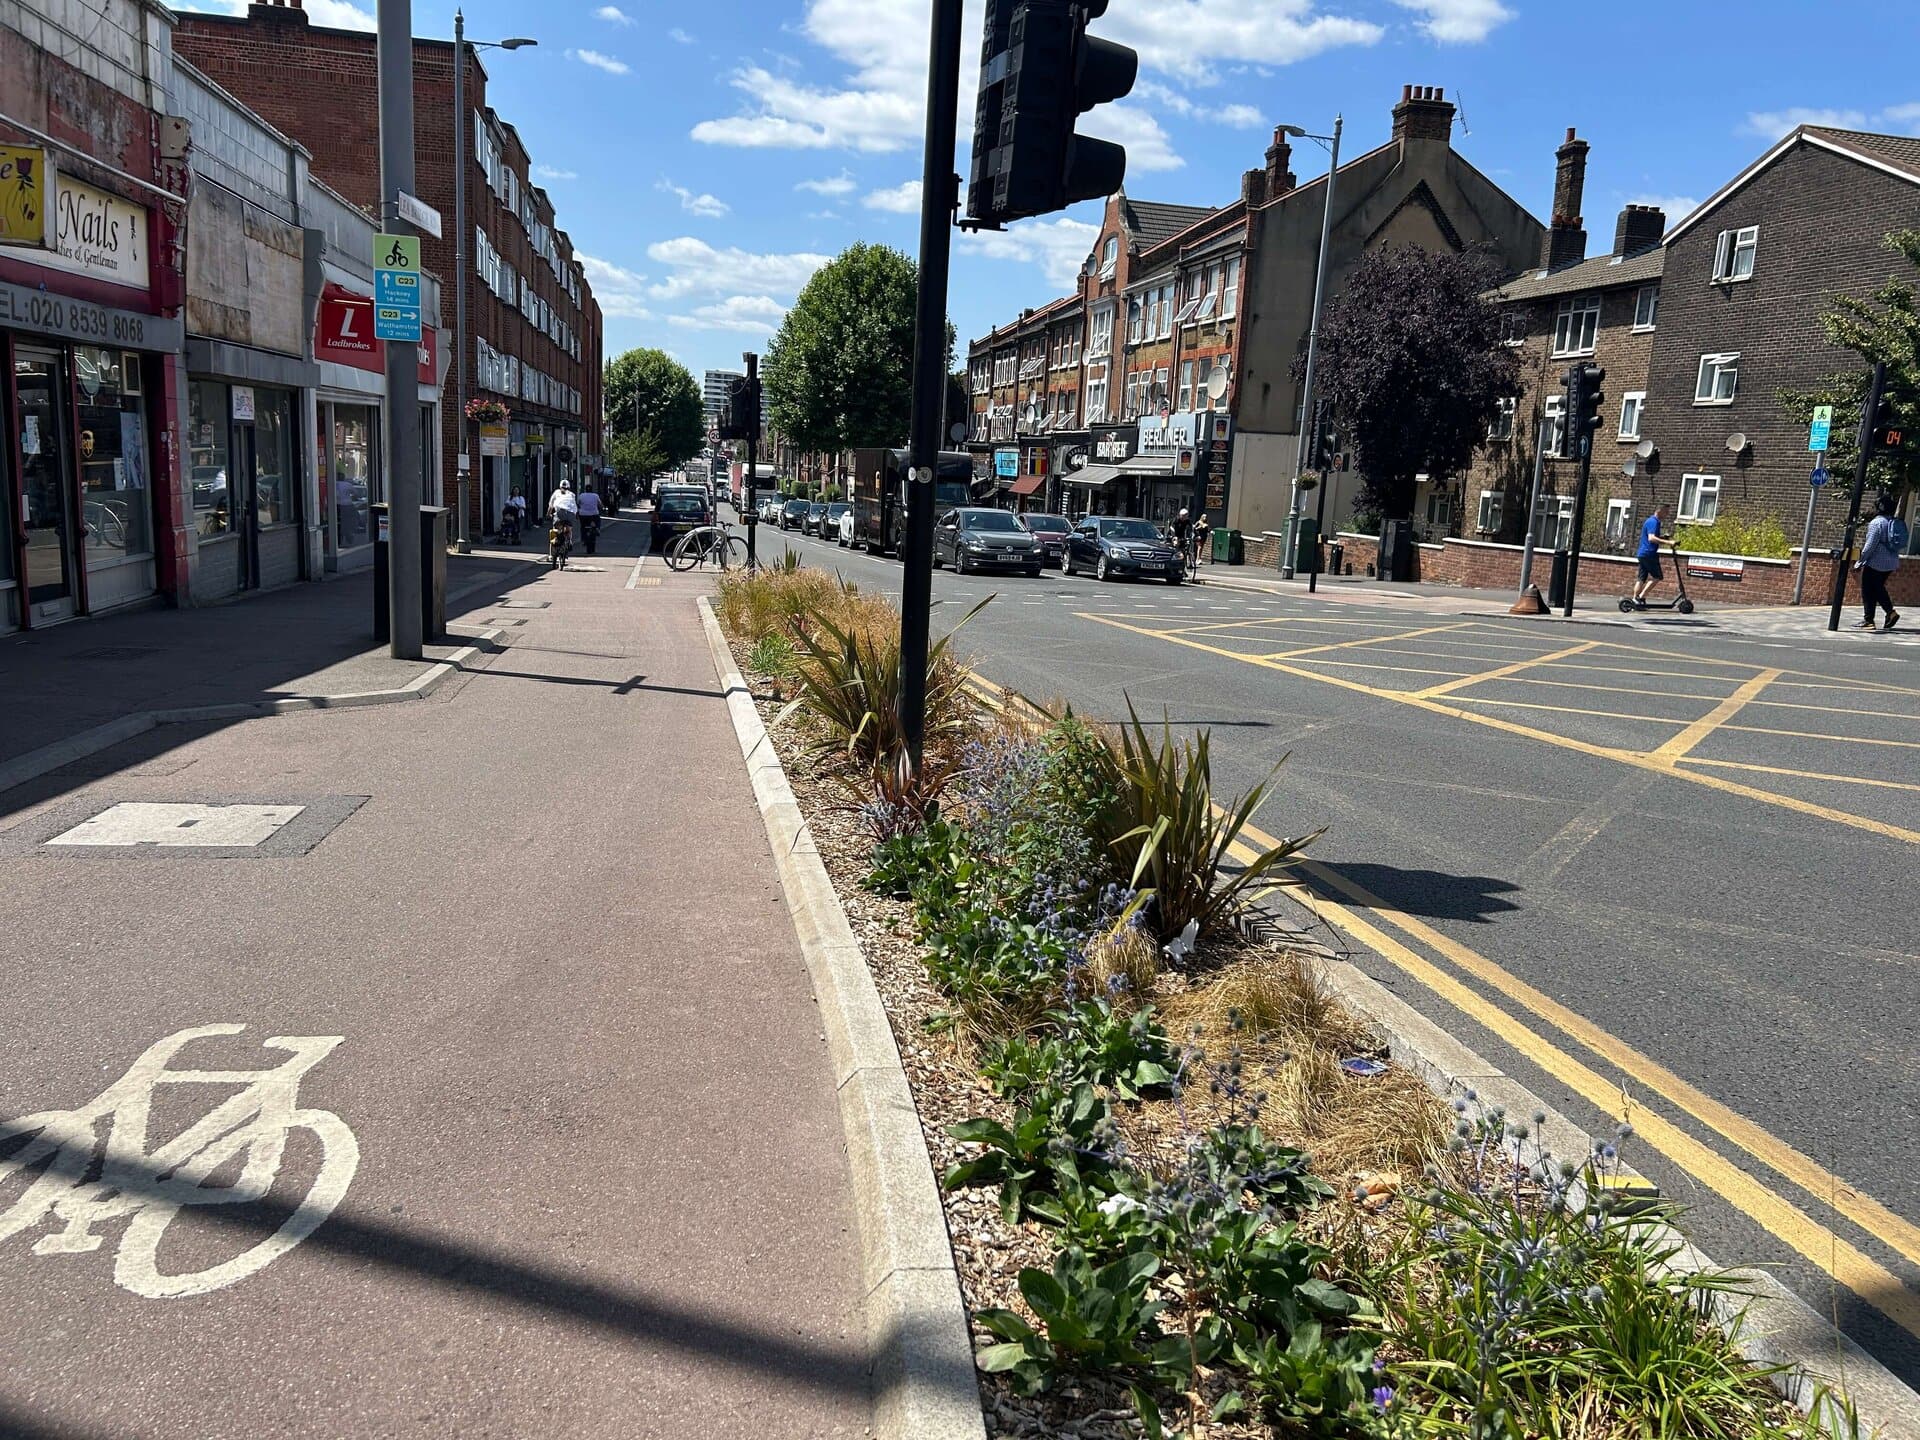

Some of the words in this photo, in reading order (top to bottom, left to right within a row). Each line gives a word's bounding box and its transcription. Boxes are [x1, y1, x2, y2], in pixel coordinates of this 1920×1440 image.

[58, 190, 119, 252] Nails
[84, 249, 118, 270] Gentleman
[398, 277, 415, 285] C23
[384, 289, 411, 298] Hackney
[382, 310, 398, 318] C23
[69, 304, 108, 336] 8539
[114, 314, 144, 342] 8068
[377, 321, 420, 331] Walthamstow
[327, 337, 371, 351] Ladbrokes
[711, 432, 721, 440] 20
[1143, 427, 1187, 447] BERLINER
[1886, 430, 1901, 446] 04
[1096, 441, 1129, 458] BARBER
